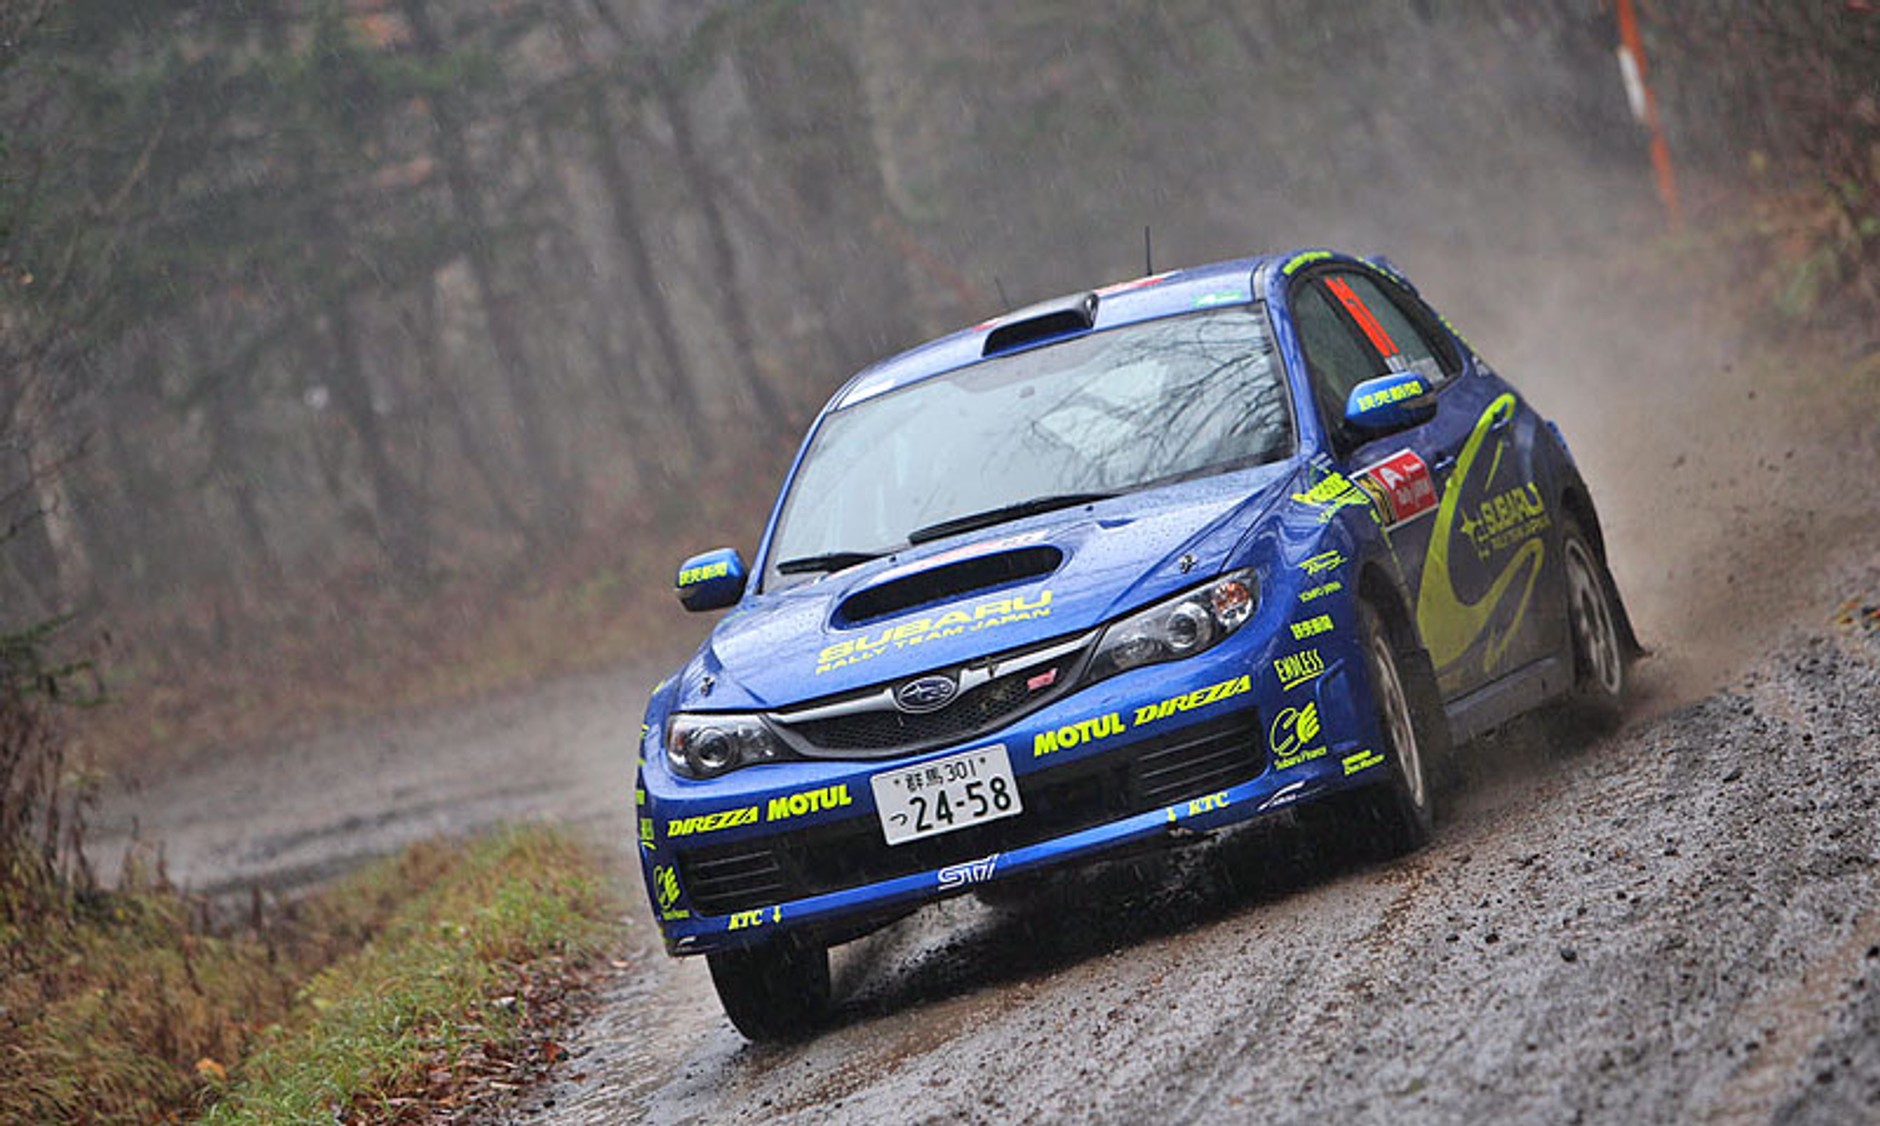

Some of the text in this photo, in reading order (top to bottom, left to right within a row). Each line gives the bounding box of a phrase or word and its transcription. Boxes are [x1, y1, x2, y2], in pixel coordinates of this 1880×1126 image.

[815, 608, 1052, 675] RALLY TEAM JAPAN
[817, 589, 1053, 664] SUBARU
[1273, 648, 1324, 683] ENDLESS
[1034, 675, 1251, 757] MOTUL DIREZZA
[667, 806, 759, 837] DIREZZA
[766, 784, 852, 821] MOTUL
[909, 776, 1012, 832] 24-58
[1188, 791, 1230, 816] KTC
